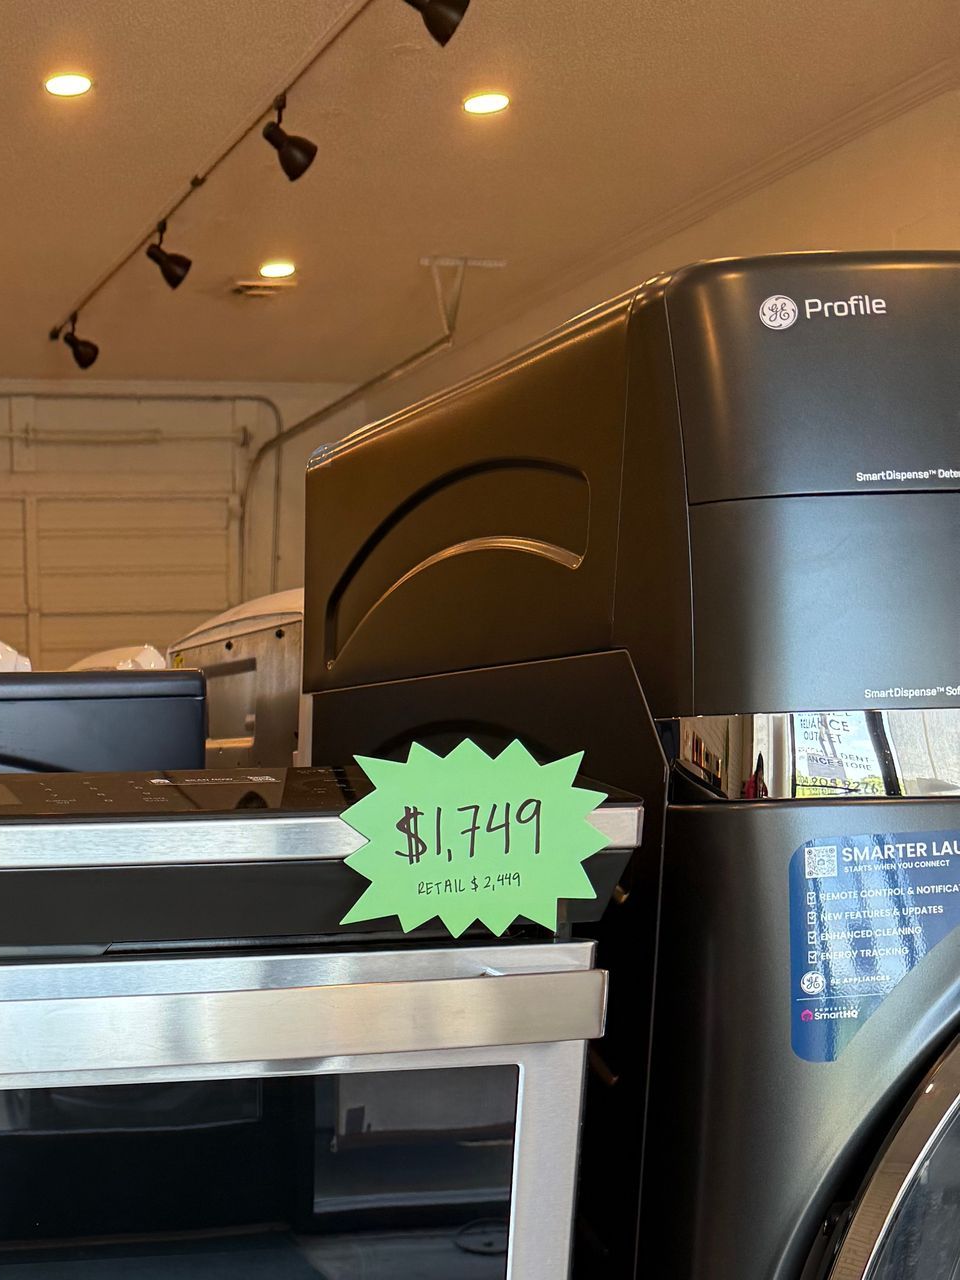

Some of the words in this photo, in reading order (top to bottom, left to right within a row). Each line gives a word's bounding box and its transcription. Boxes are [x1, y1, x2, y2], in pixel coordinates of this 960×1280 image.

[805, 295, 887, 319] Profile
[395, 799, 542, 865] $1,749
[842, 843, 927, 862] SMARTER
[844, 864, 872, 873] STARTS
[873, 862, 896, 872] WHEN
[898, 861, 913, 869] YOU
[914, 859, 950, 868] CONNECT
[418, 879, 465, 895] RETAIL
[820, 891, 859, 901] REMOTE
[860, 887, 906, 898] CONTROL
[907, 886, 915, 895] &
[820, 912, 842, 921] NEW
[844, 908, 893, 920] FEATURES
[892, 907, 900, 917] &
[902, 905, 944, 916] UPDATES
[820, 929, 873, 941] ENHANCED
[875, 926, 922, 938] CLEANING
[820, 949, 858, 961] ENERGY
[860, 946, 909, 958] TRACKING
[814, 1010, 859, 1020] SmartHQ
